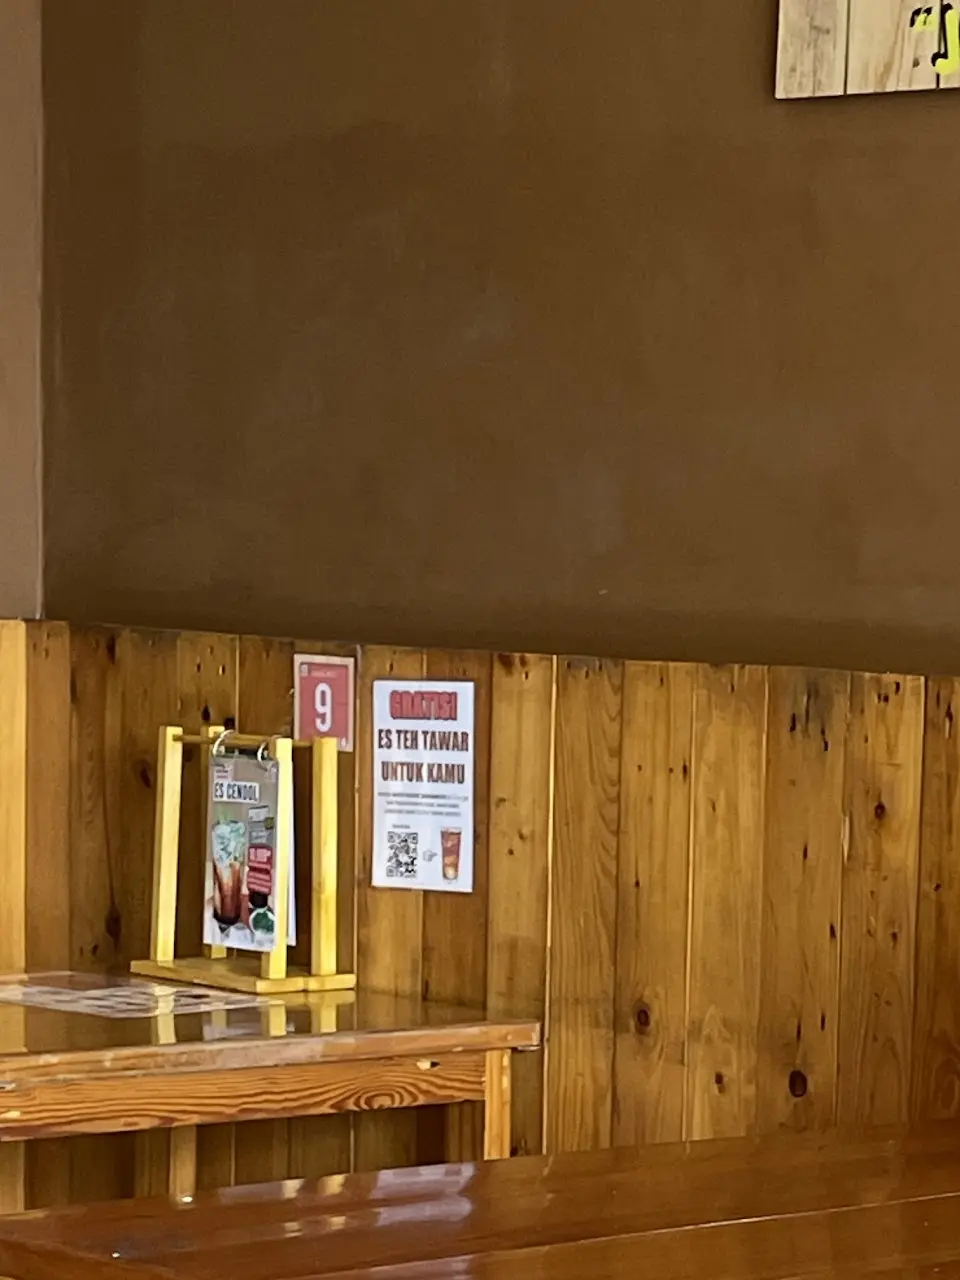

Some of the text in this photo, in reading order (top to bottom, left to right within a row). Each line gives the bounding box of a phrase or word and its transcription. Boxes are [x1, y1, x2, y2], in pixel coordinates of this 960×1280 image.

[314, 682, 332, 732] 9
[378, 728, 469, 752] ES TEH TAWAR
[381, 761, 465, 784] UNTUK KAMU
